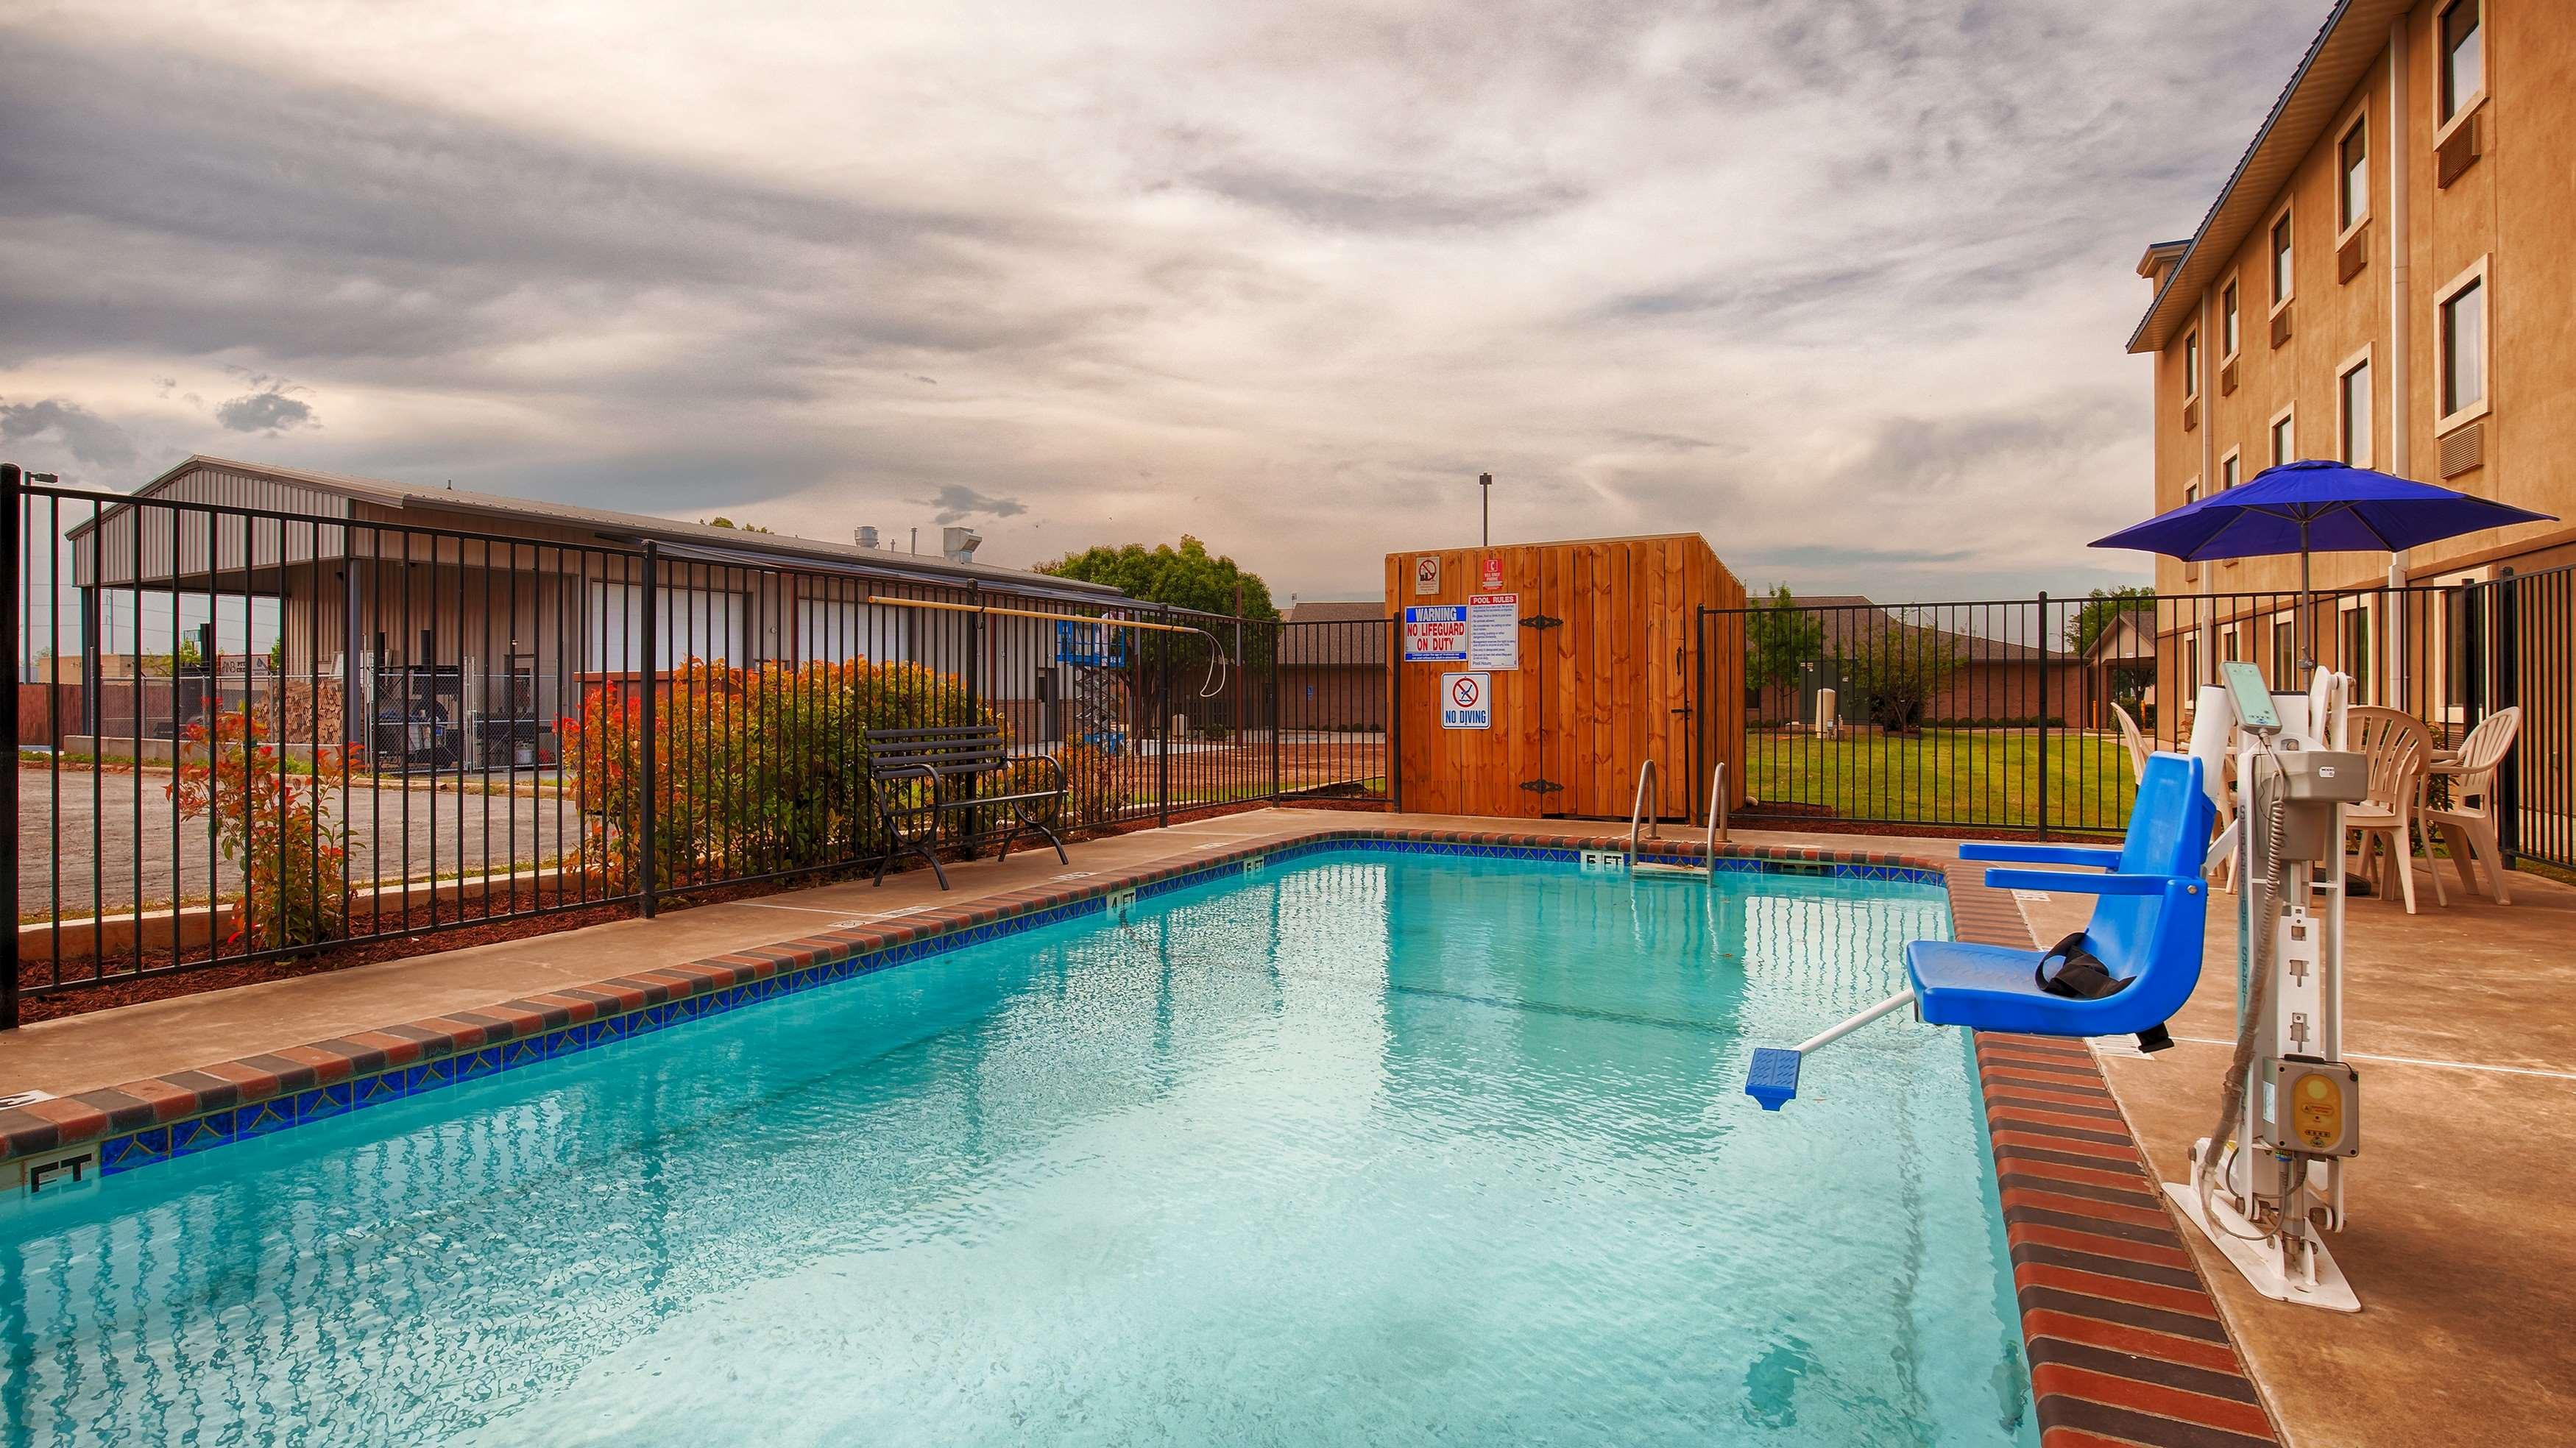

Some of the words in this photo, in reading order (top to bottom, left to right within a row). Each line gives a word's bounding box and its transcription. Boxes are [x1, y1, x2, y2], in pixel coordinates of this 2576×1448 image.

[1415, 607, 1457, 622] WARNING
[1407, 623, 1418, 636] NO
[1421, 622, 1465, 636] LIFEGUARD
[1417, 638, 1428, 651] ON
[1433, 637, 1454, 650] DUTY
[1446, 710, 1457, 723] NO
[1459, 710, 1486, 724] DIVING
[1254, 859, 1263, 872] FT
[1604, 855, 1621, 866] FT
[1122, 892, 1135, 906] FT
[31, 1153, 92, 1193] FT
